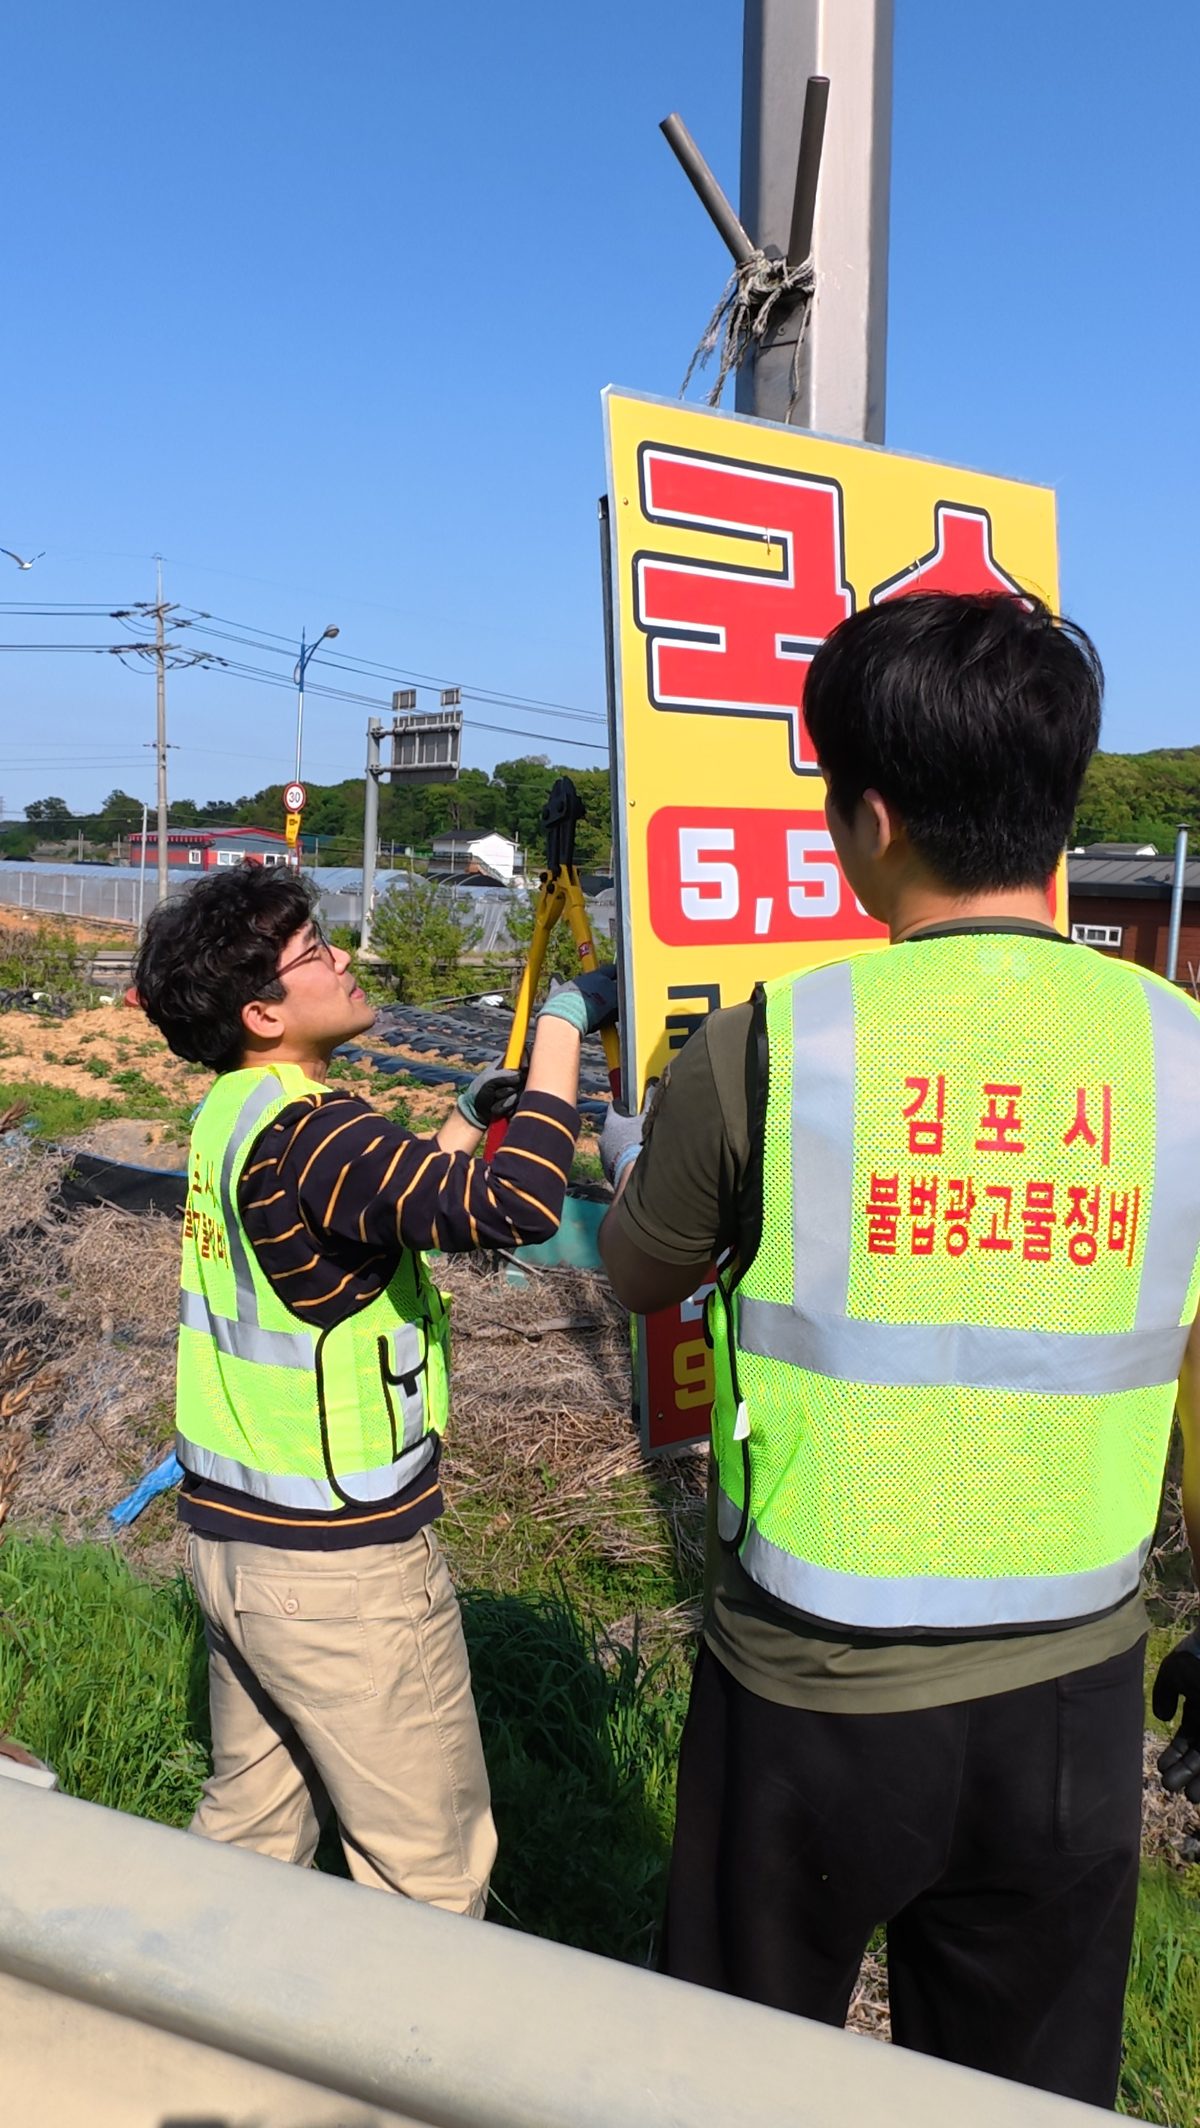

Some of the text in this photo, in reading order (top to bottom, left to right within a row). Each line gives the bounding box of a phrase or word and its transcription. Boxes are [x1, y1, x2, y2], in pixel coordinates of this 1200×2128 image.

[288, 791, 301, 803] 30
[677, 827, 873, 935] 5,5
[865, 1172, 1140, 1267] 불법광고물정비
